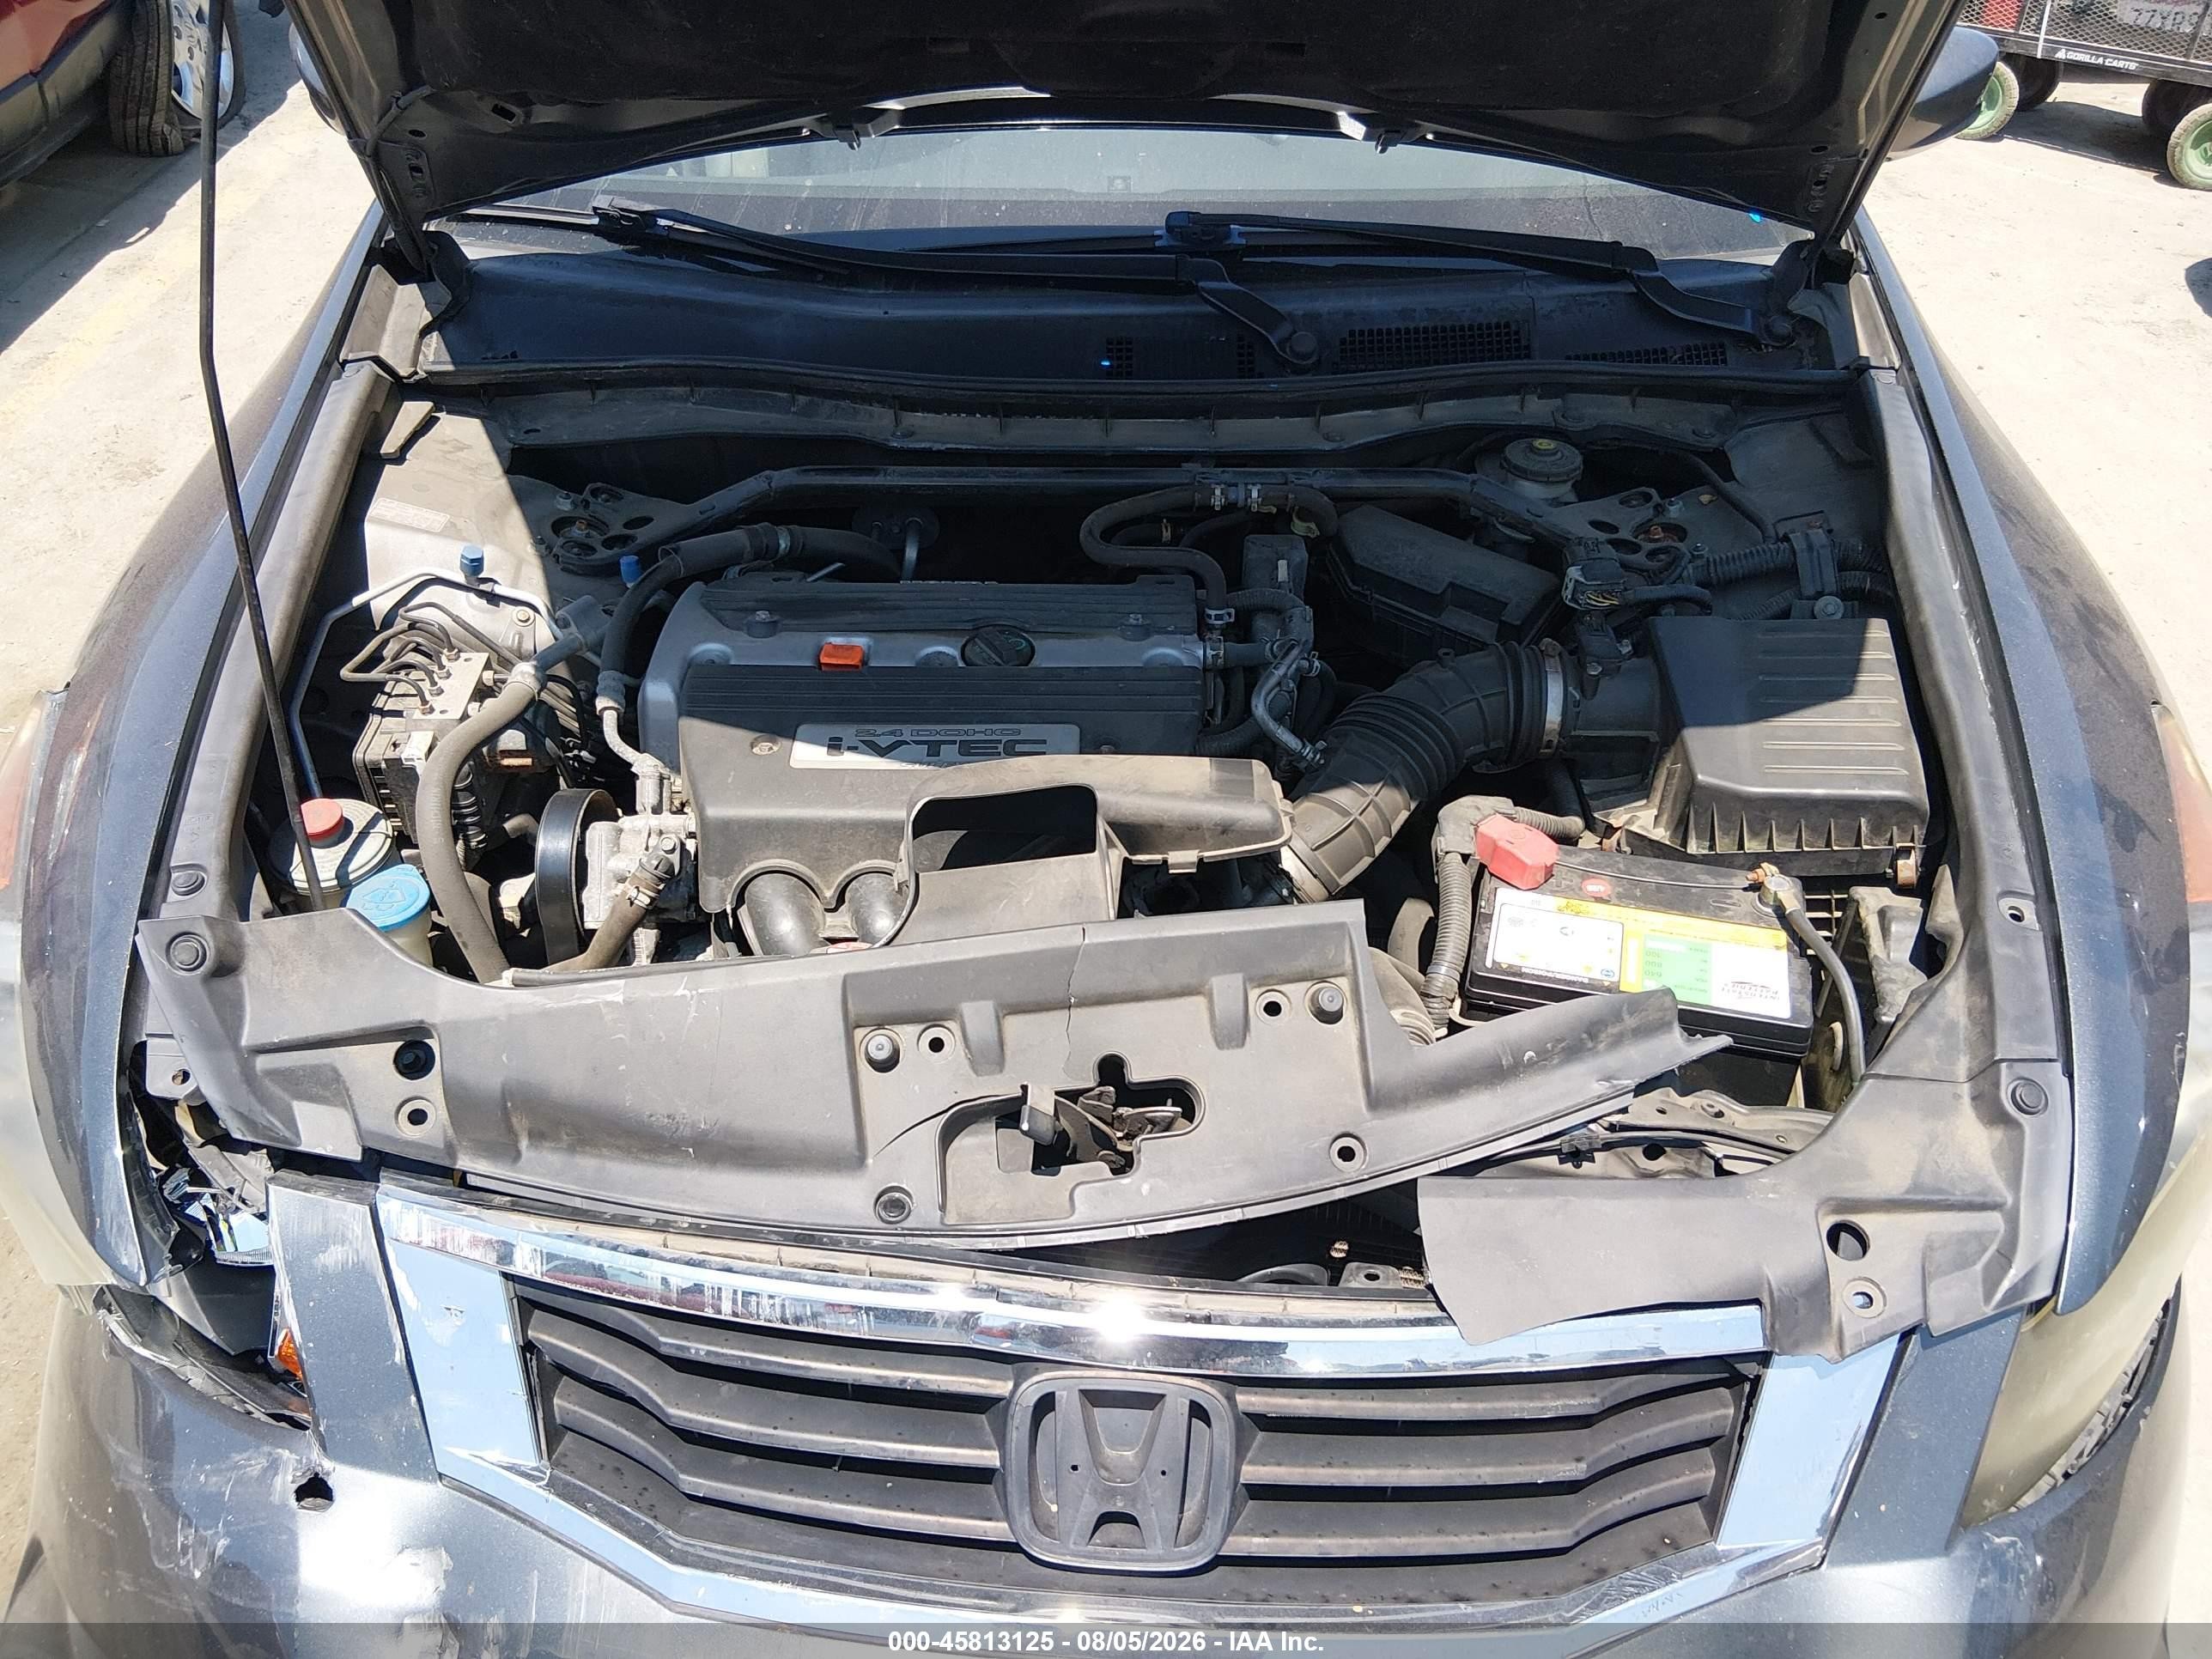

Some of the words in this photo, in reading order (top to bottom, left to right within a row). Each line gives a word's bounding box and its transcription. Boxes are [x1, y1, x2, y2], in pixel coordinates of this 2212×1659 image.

[2066, 52, 2104, 65] GORILLA
[2104, 58, 2138, 70] CARTS
[854, 728, 902, 738] 2.4
[910, 728, 1021, 737] DOHC
[827, 736, 1048, 757] i-VTEC
